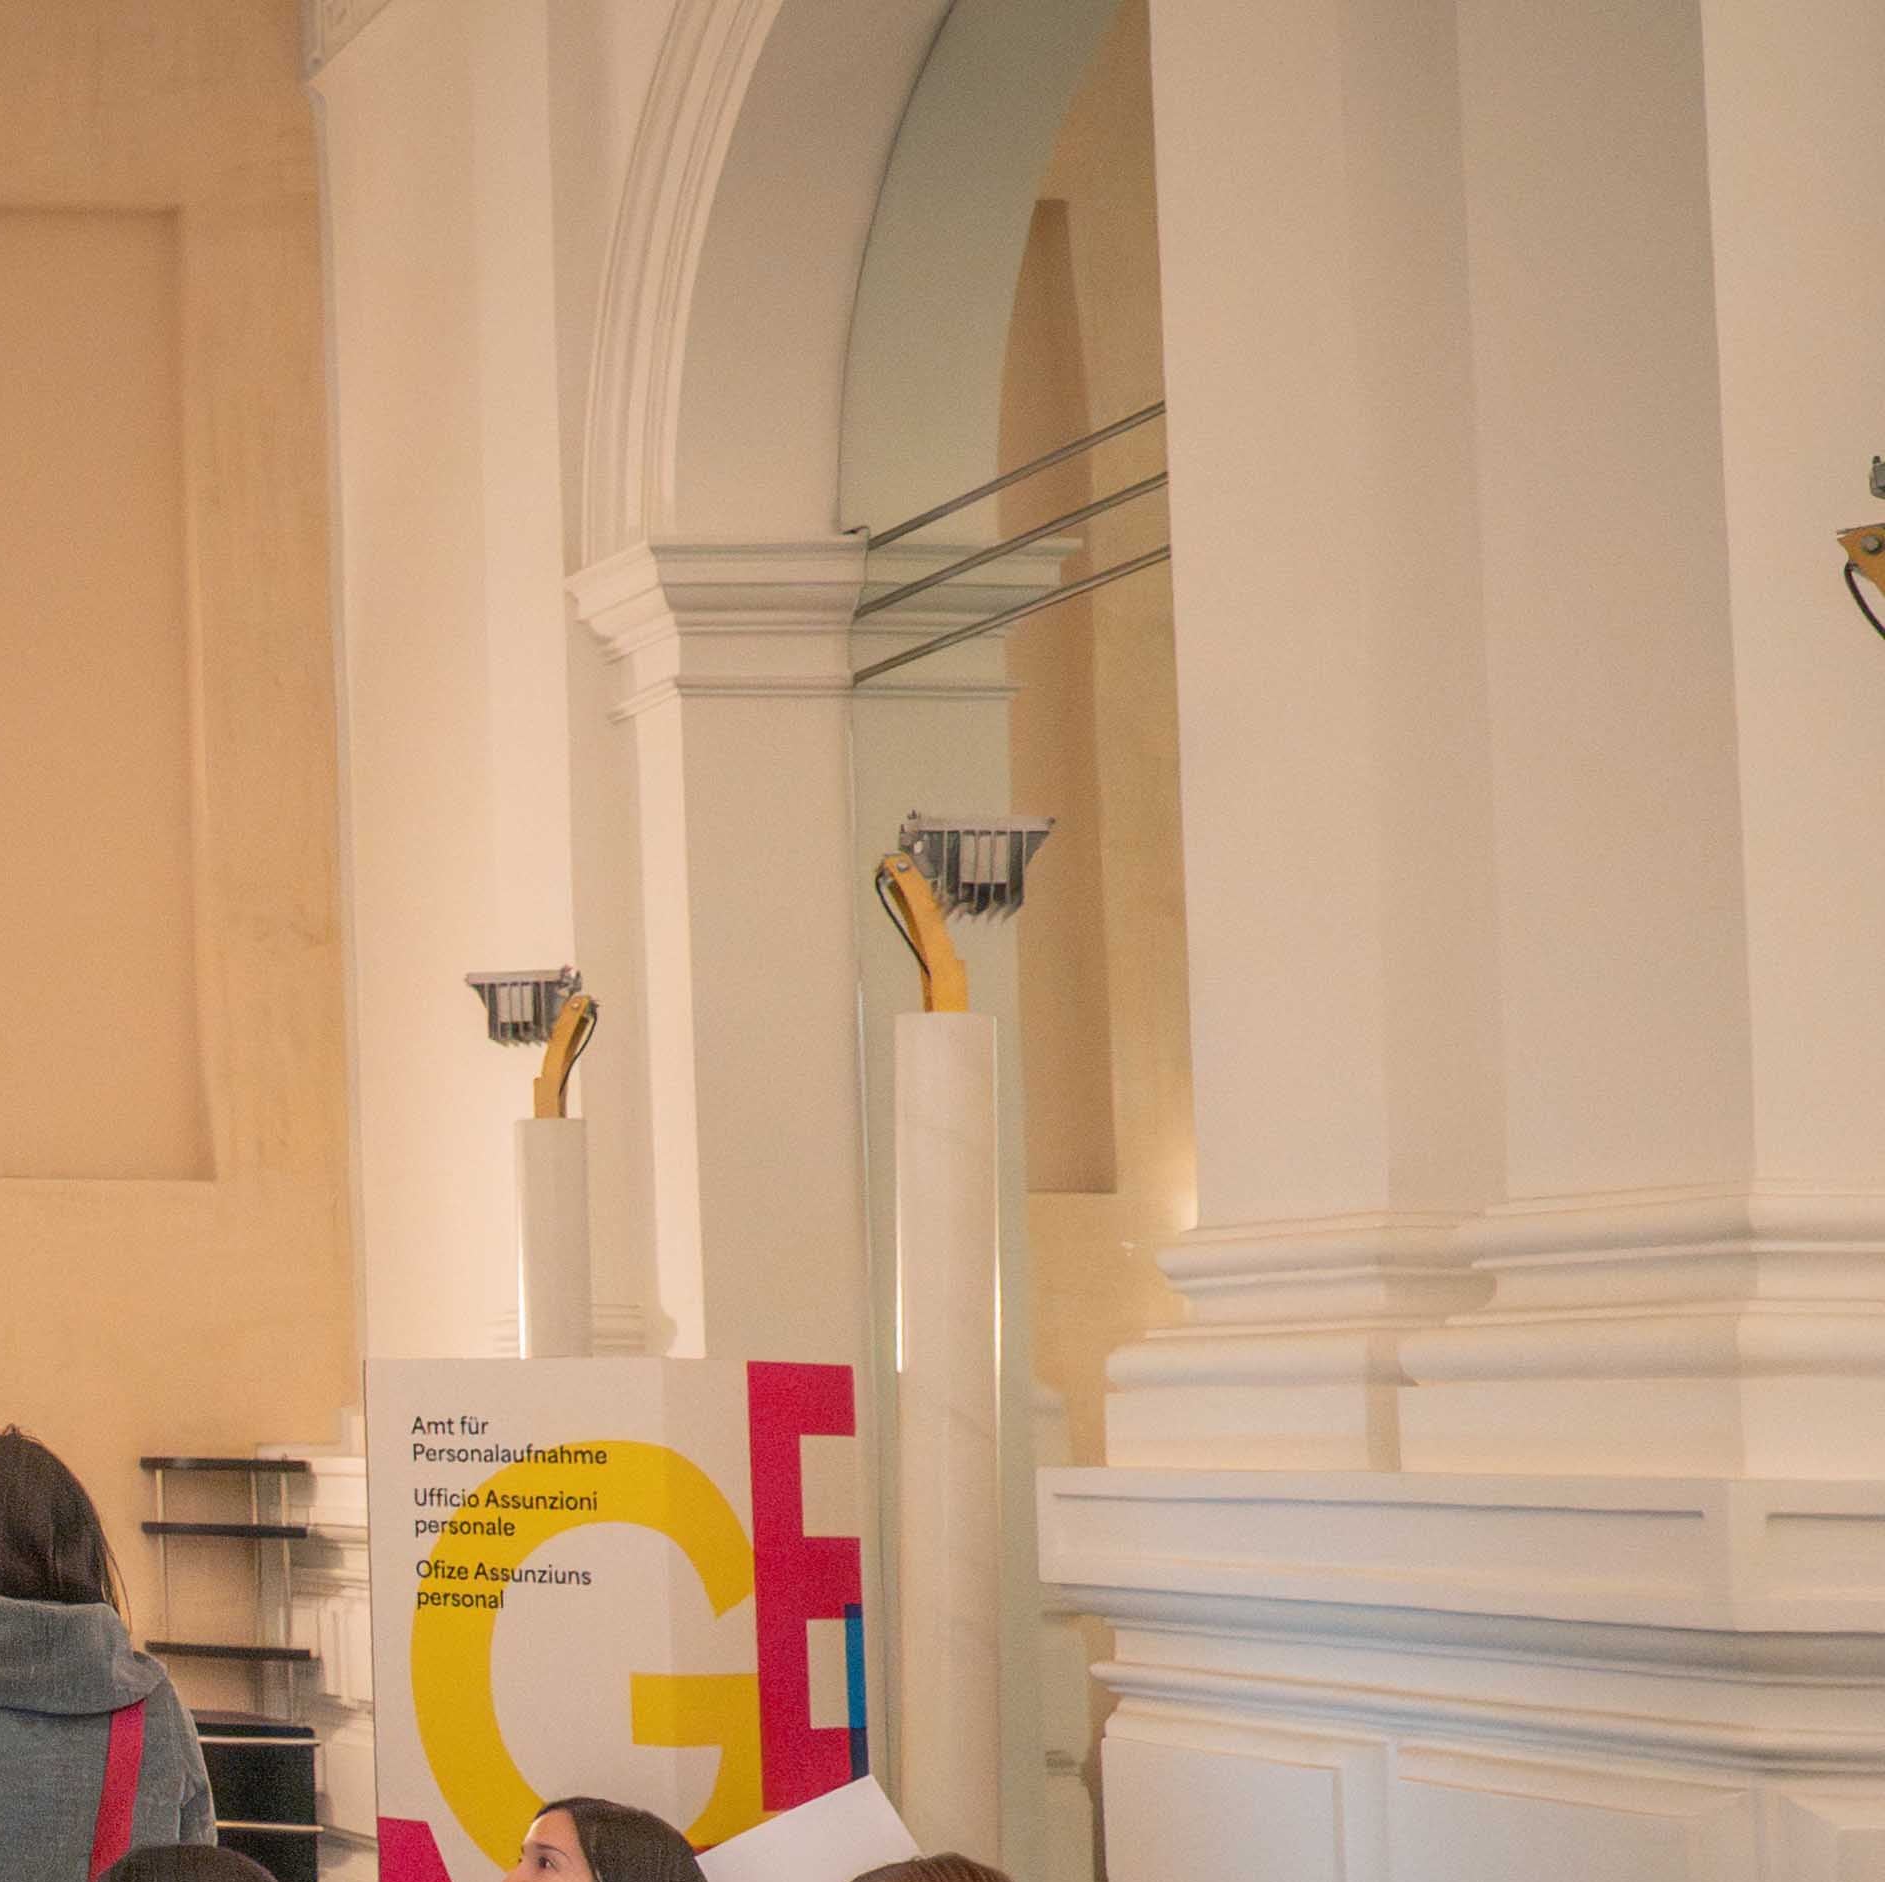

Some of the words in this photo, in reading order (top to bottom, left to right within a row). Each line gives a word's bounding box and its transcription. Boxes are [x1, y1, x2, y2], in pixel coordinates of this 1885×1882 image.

[411, 1416, 455, 1435] Amt
[460, 1416, 489, 1435] für
[412, 1443, 608, 1465] Personalaufnahme
[414, 1487, 480, 1509] Ufficio
[484, 1489, 599, 1511] Assunzioni
[415, 1516, 516, 1538] personale
[416, 1559, 469, 1580] Ofize
[474, 1562, 592, 1586] Assunziuns
[417, 1590, 505, 1610] personal
